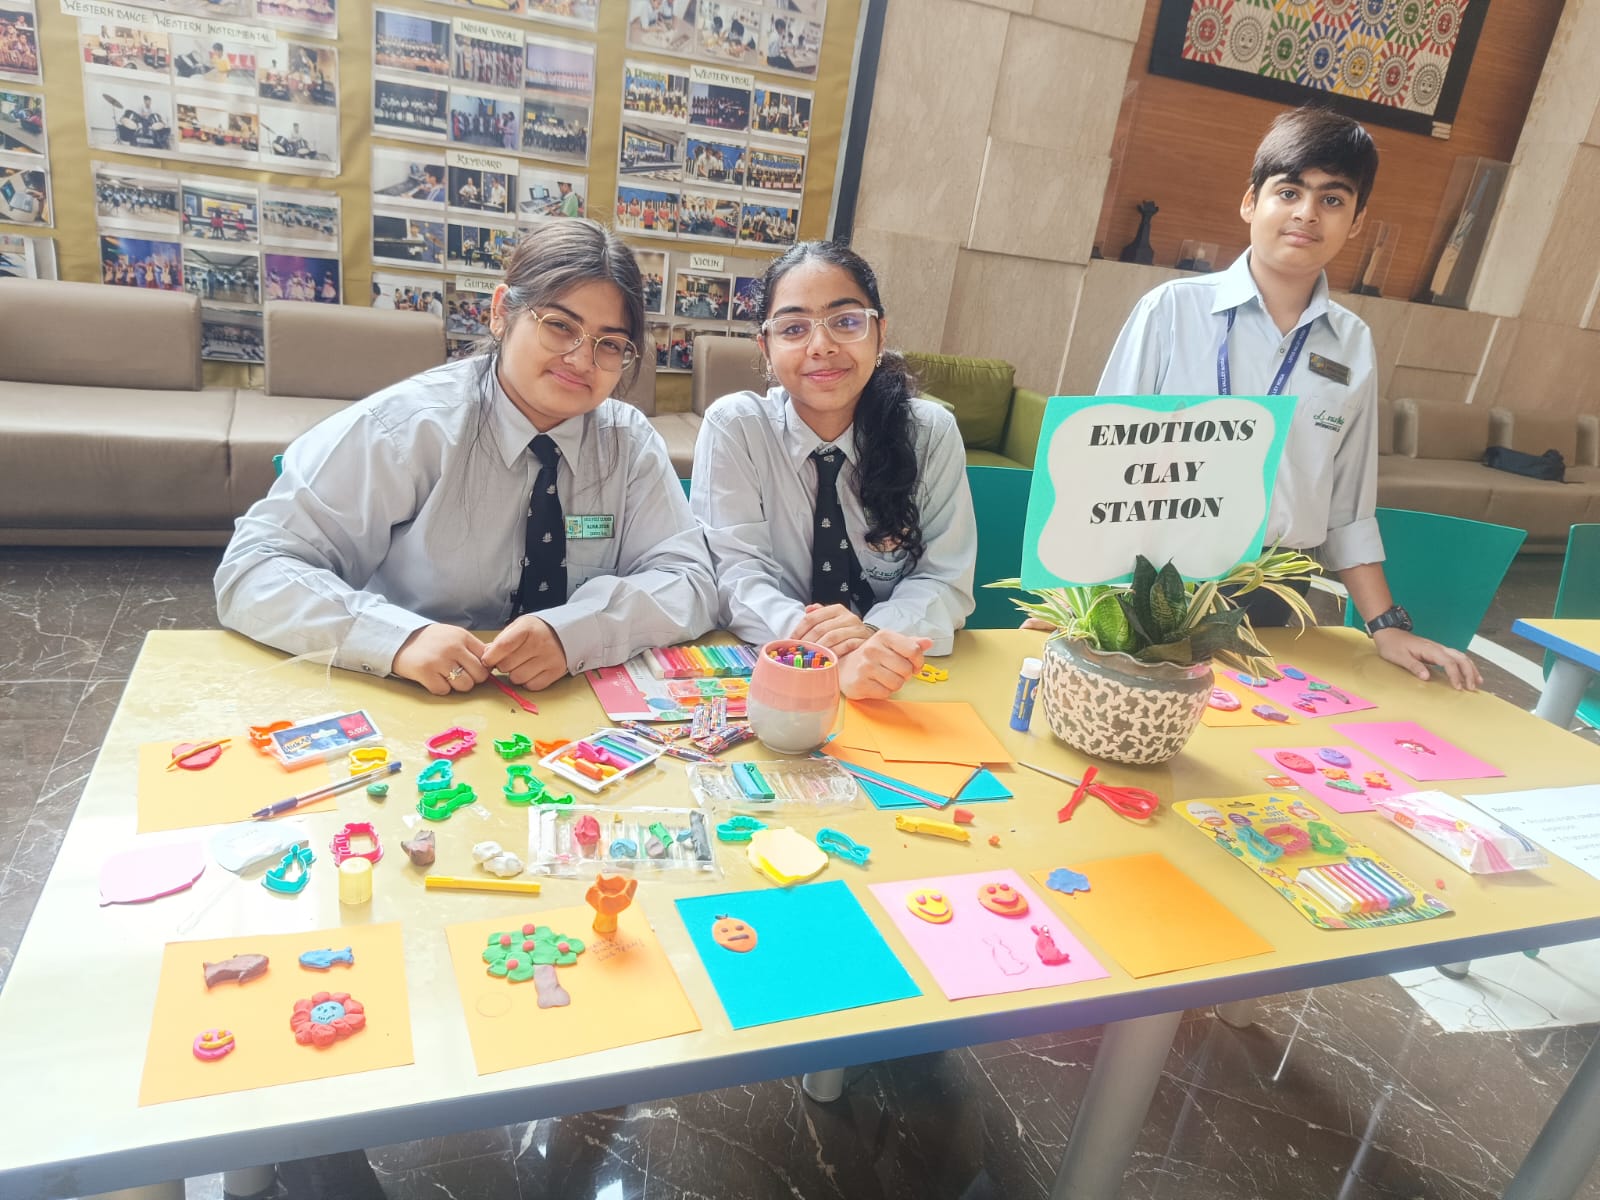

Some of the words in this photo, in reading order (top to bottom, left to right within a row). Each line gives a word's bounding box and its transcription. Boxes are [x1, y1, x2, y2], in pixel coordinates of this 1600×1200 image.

[63, 0, 115, 17] WESTERN
[116, 9, 148, 24] DANCE
[155, 14, 202, 32] WESTERN
[207, 23, 271, 42] INSTRUMENTAL
[460, 21, 488, 35] INDIAN
[490, 30, 519, 42] VOCAL
[693, 68, 729, 82] WESTERN
[730, 75, 750, 87] VOCAL
[457, 153, 503, 169] KEYBOARD
[693, 256, 720, 267] VIOLIN
[464, 278, 497, 290] GUITAR
[1088, 419, 1257, 446] EMOTIONS
[1123, 461, 1206, 486] CLAY
[1089, 497, 1225, 525] STATION
